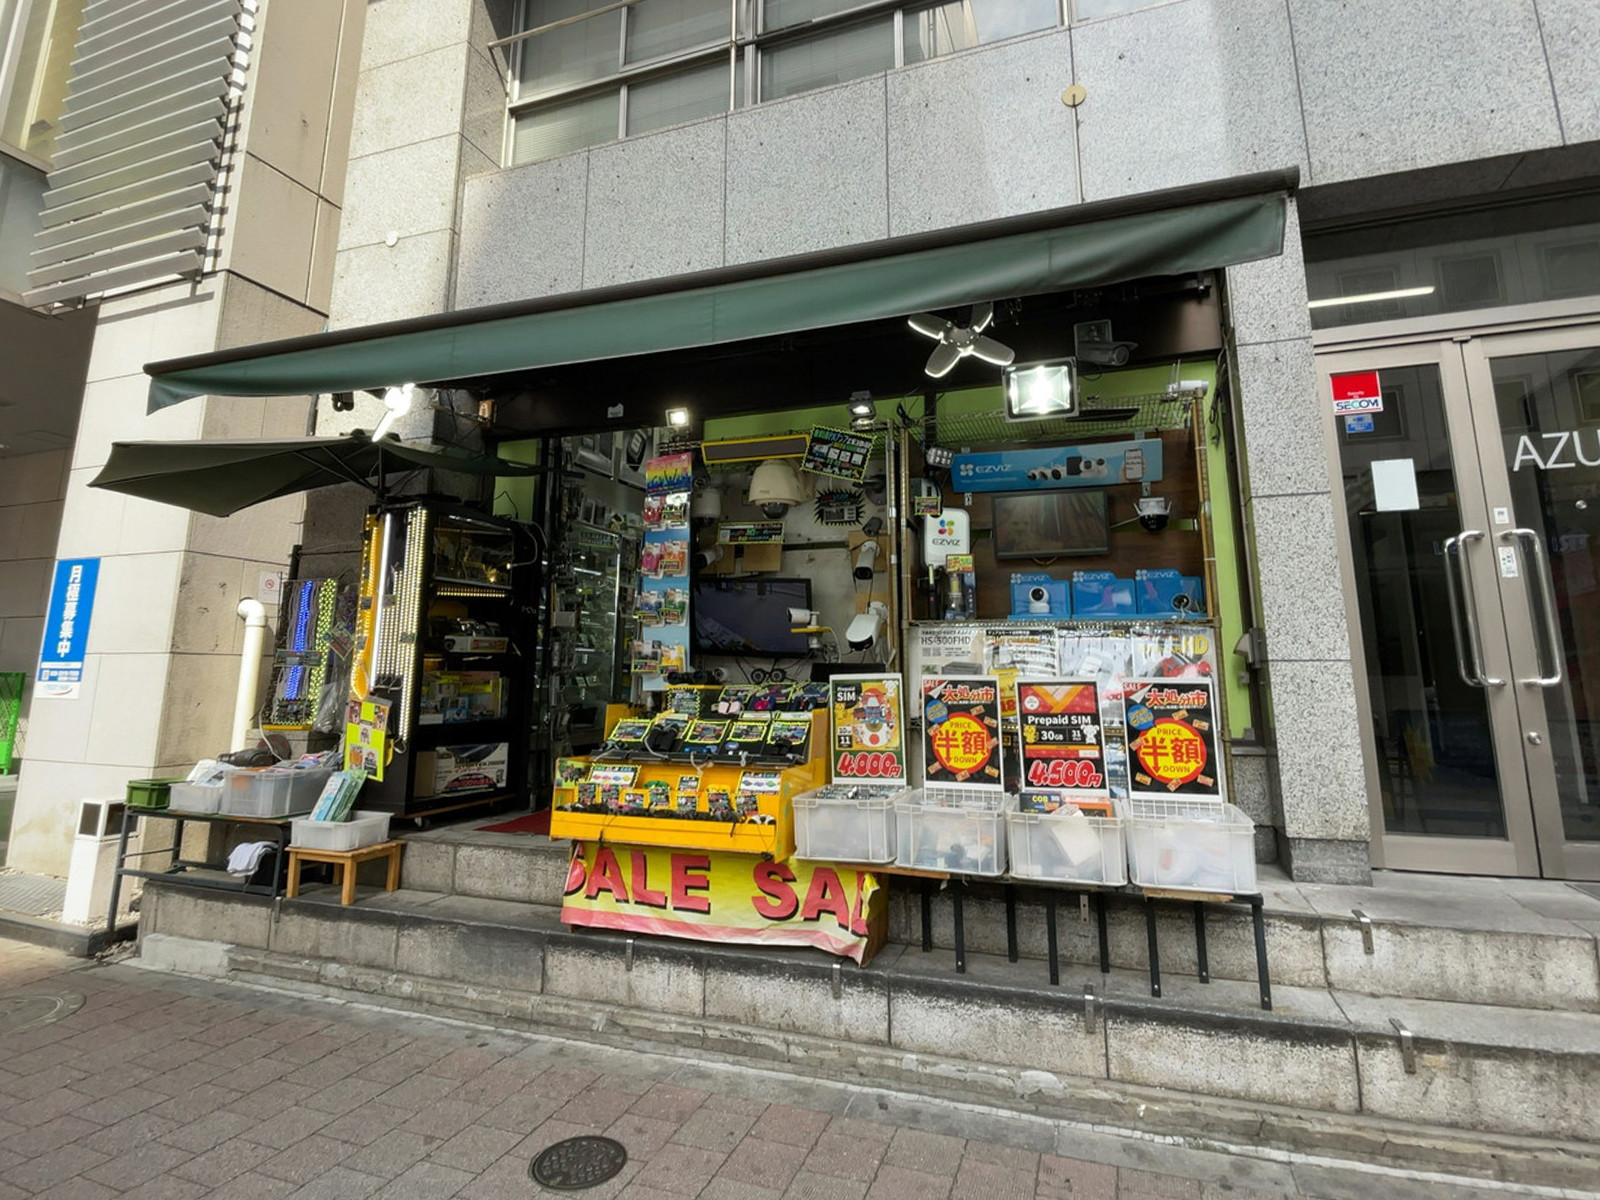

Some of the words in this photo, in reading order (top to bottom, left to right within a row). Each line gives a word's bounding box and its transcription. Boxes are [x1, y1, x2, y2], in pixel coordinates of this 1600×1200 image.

[1336, 398, 1379, 411] SECOM
[976, 463, 1013, 474] EZVIZ
[932, 538, 962, 546] EZVIZ
[1083, 572, 1110, 580] EZVIZ
[1146, 571, 1174, 579] EZVIZ
[56, 565, 83, 658] 月極募集中
[837, 692, 856, 702] SIM
[942, 684, 995, 703] 大処分市
[1145, 688, 1207, 707] 大処分市
[1028, 715, 1068, 726] Prepaid
[1071, 715, 1091, 724] SIM
[1157, 728, 1182, 736] PRICE
[840, 736, 851, 744] 11
[936, 730, 988, 764] 半額
[954, 756, 977, 764] DOWN
[1140, 736, 1202, 776] 半額
[1163, 765, 1190, 773] DOWN
